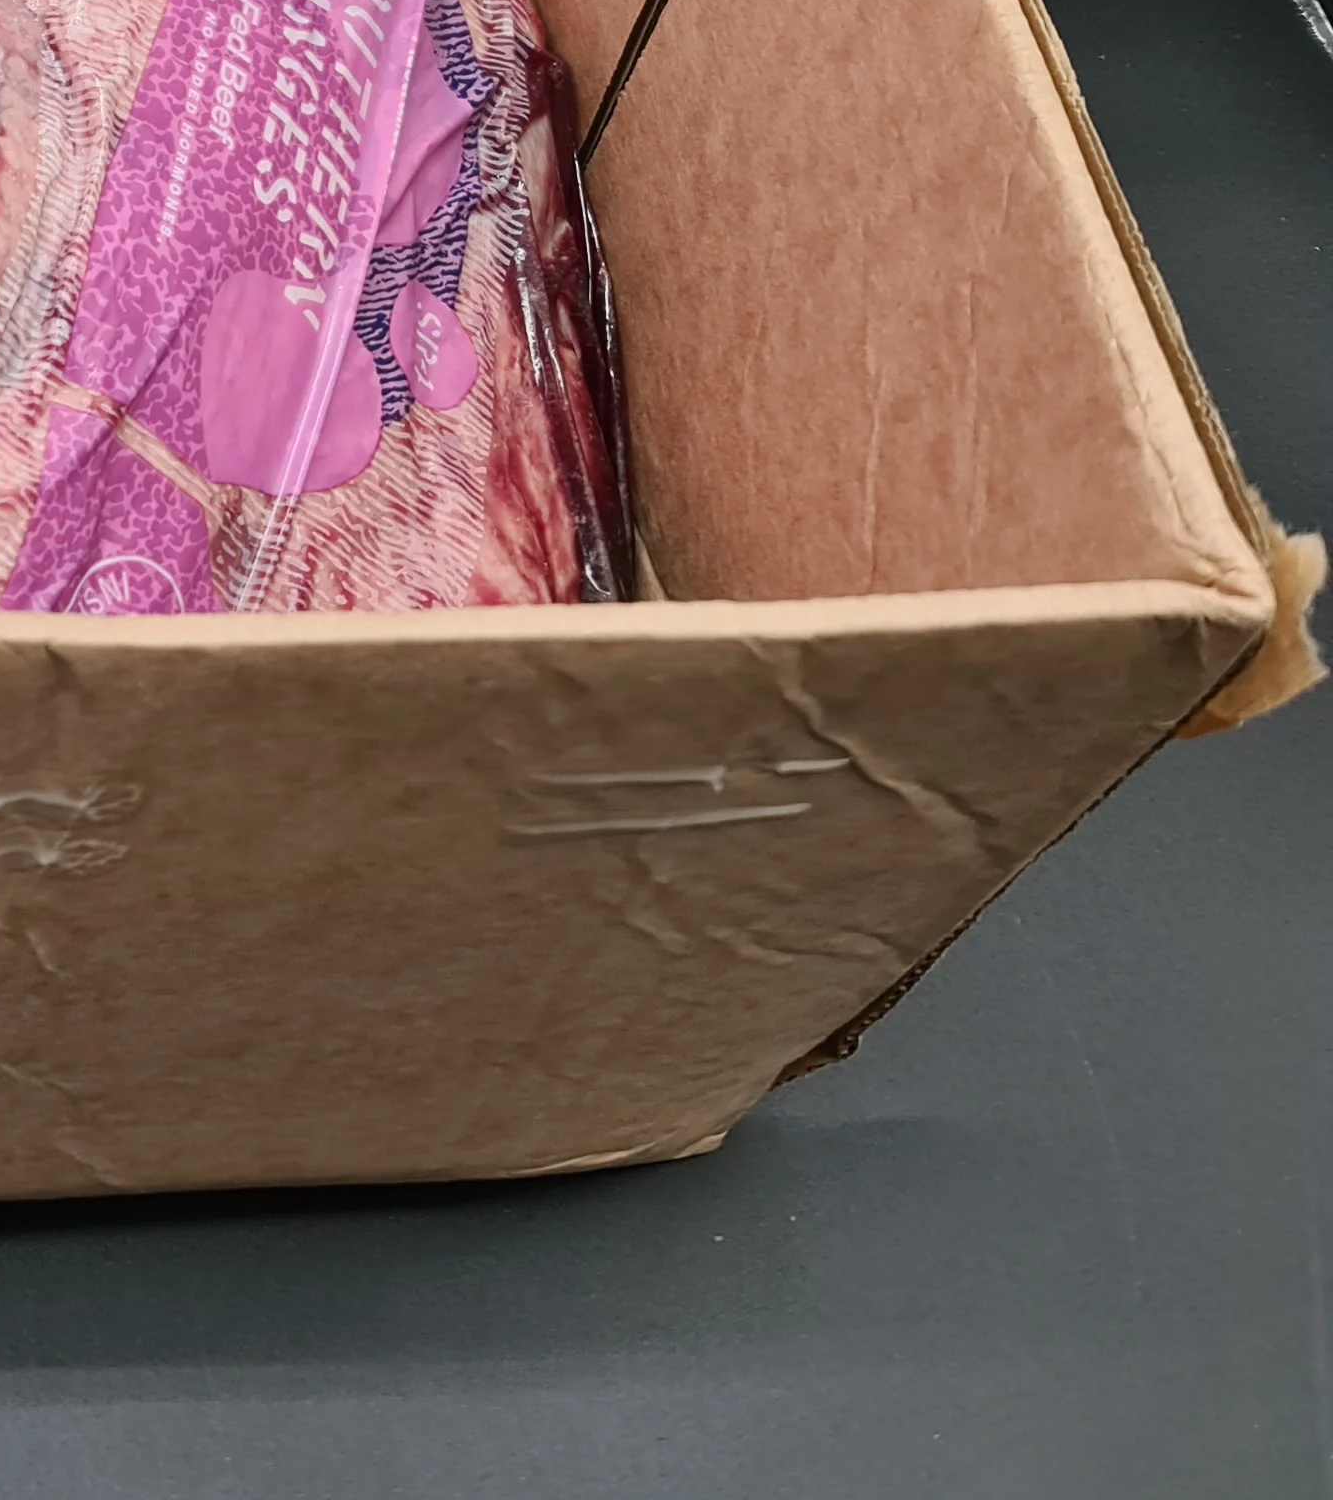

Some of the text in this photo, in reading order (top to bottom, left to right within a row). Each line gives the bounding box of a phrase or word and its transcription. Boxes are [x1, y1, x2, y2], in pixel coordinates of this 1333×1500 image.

[200, 11, 215, 41] NO
[182, 46, 210, 114] ADDED
[212, 61, 249, 151] Beef
